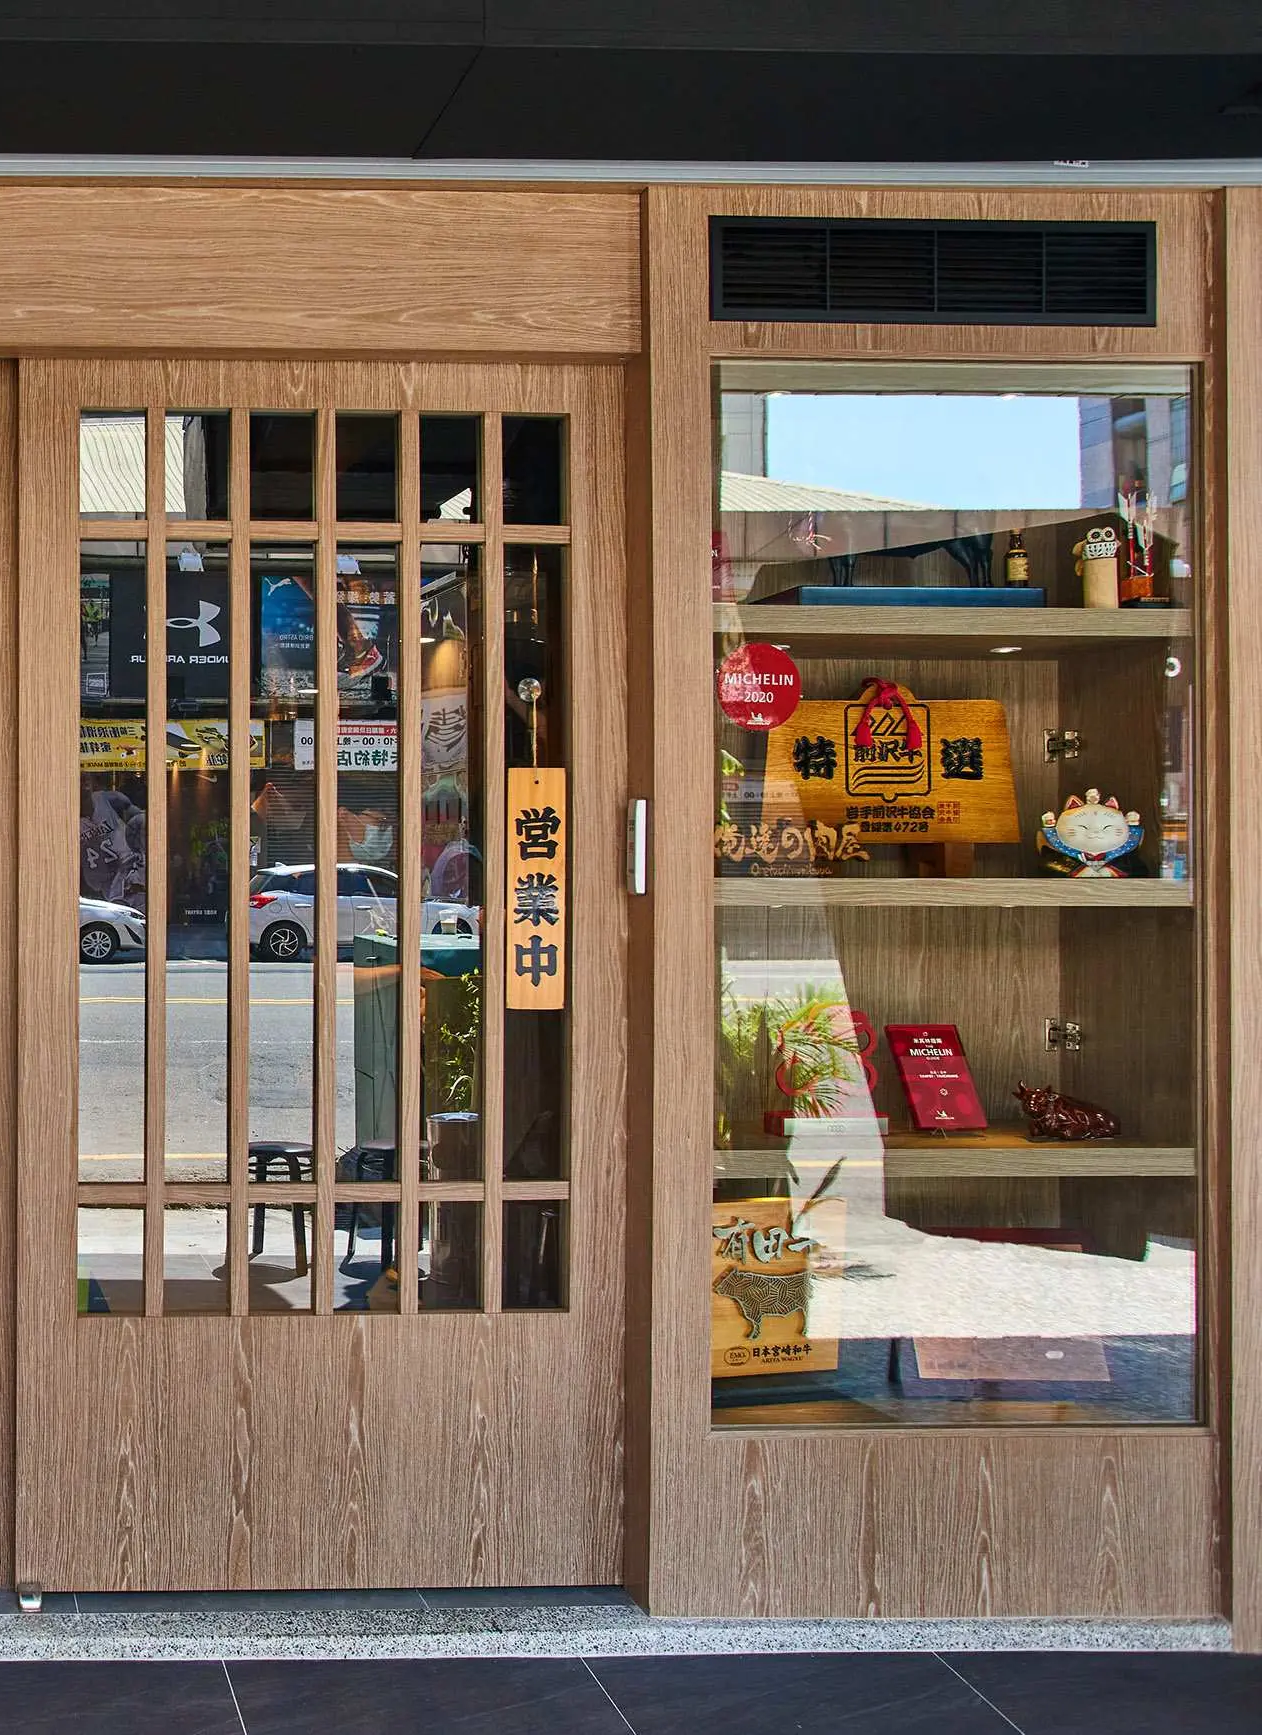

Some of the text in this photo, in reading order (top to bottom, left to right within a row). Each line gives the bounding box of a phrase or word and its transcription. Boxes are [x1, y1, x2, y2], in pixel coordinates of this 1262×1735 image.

[724, 673, 794, 686] MICHELIN
[744, 691, 774, 703] 2020
[793, 736, 985, 780] 特 選
[514, 806, 561, 987] 営業中
[909, 1048, 954, 1057] MICHELIN
[752, 1343, 813, 1358] 日本宮崎和牛
